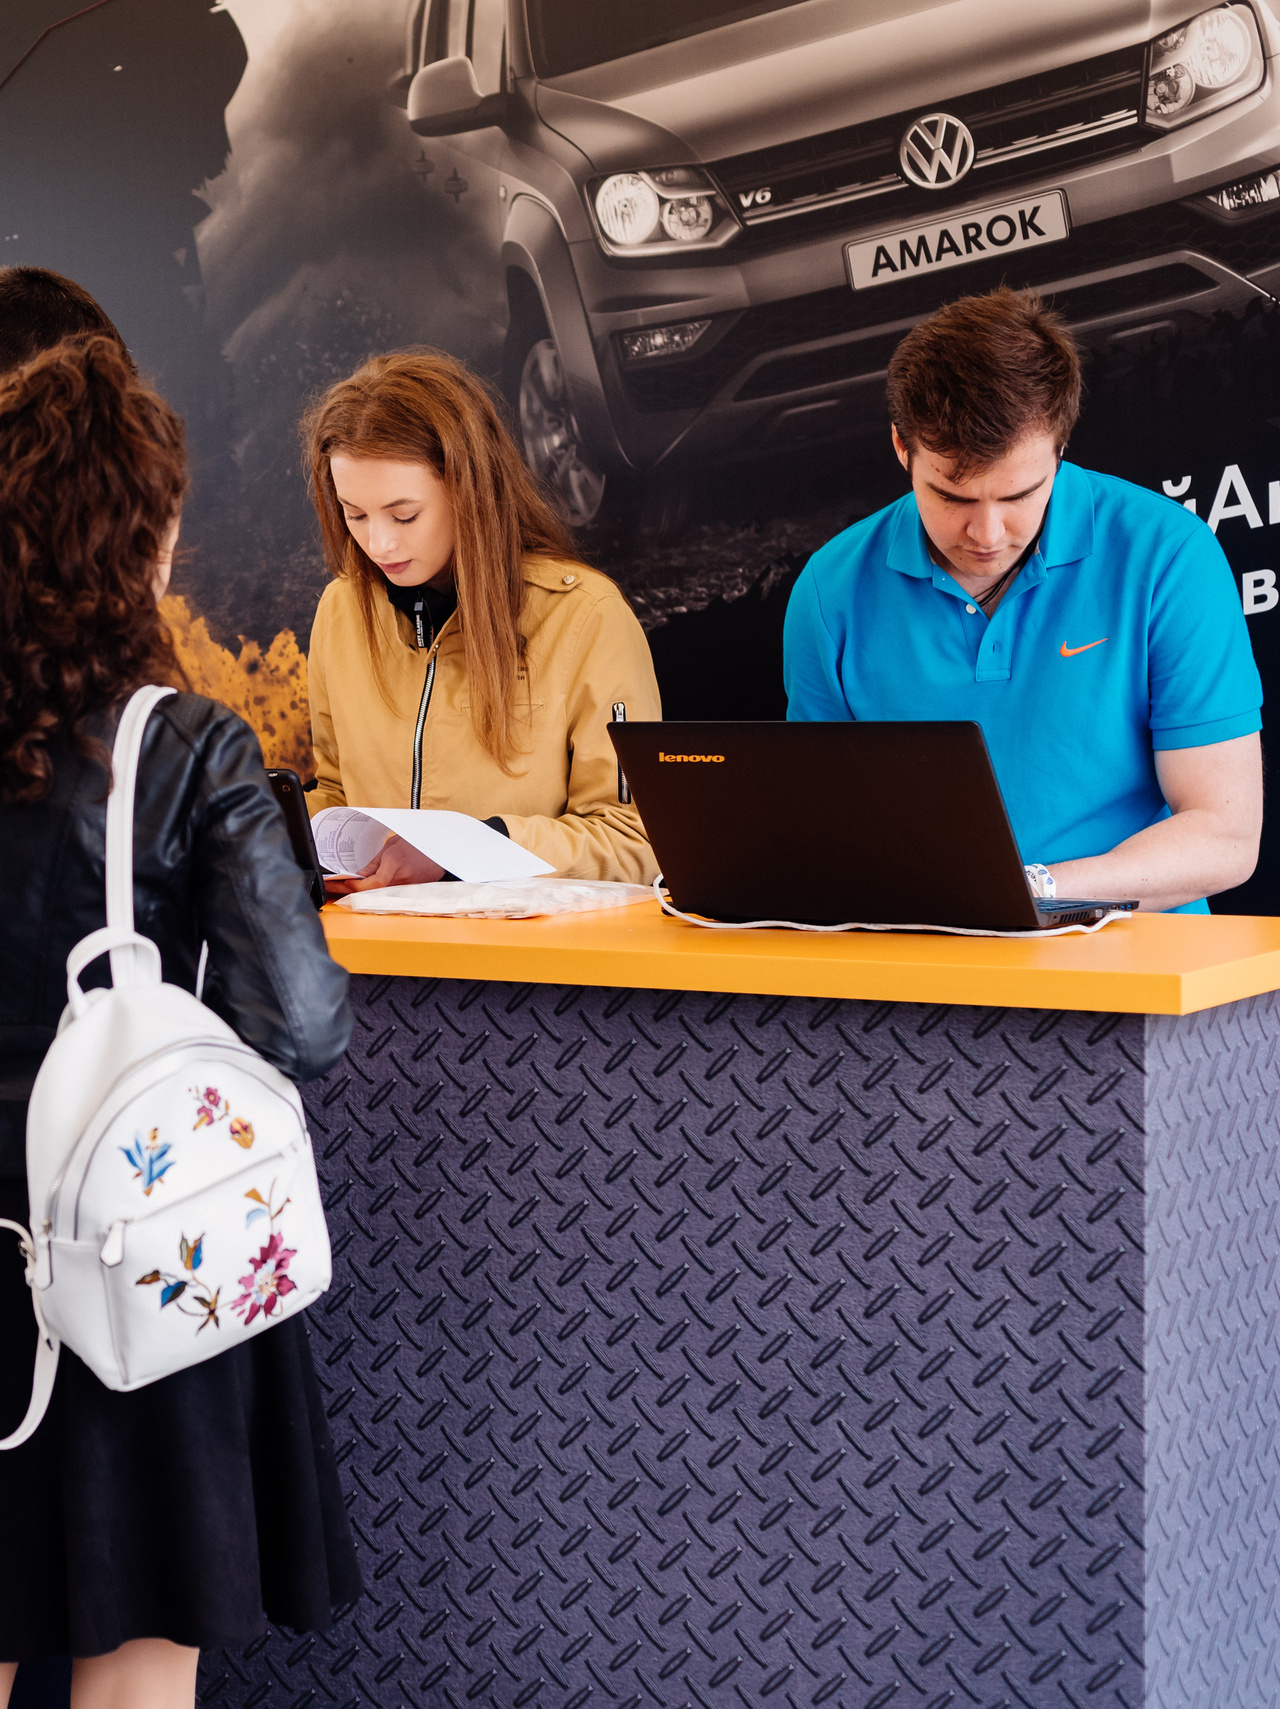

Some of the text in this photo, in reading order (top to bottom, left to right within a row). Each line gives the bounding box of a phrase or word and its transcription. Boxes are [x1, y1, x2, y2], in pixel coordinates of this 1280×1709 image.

[738, 186, 772, 208] V6
[871, 205, 1047, 278] AMAROK
[658, 752, 726, 763] lenovo
